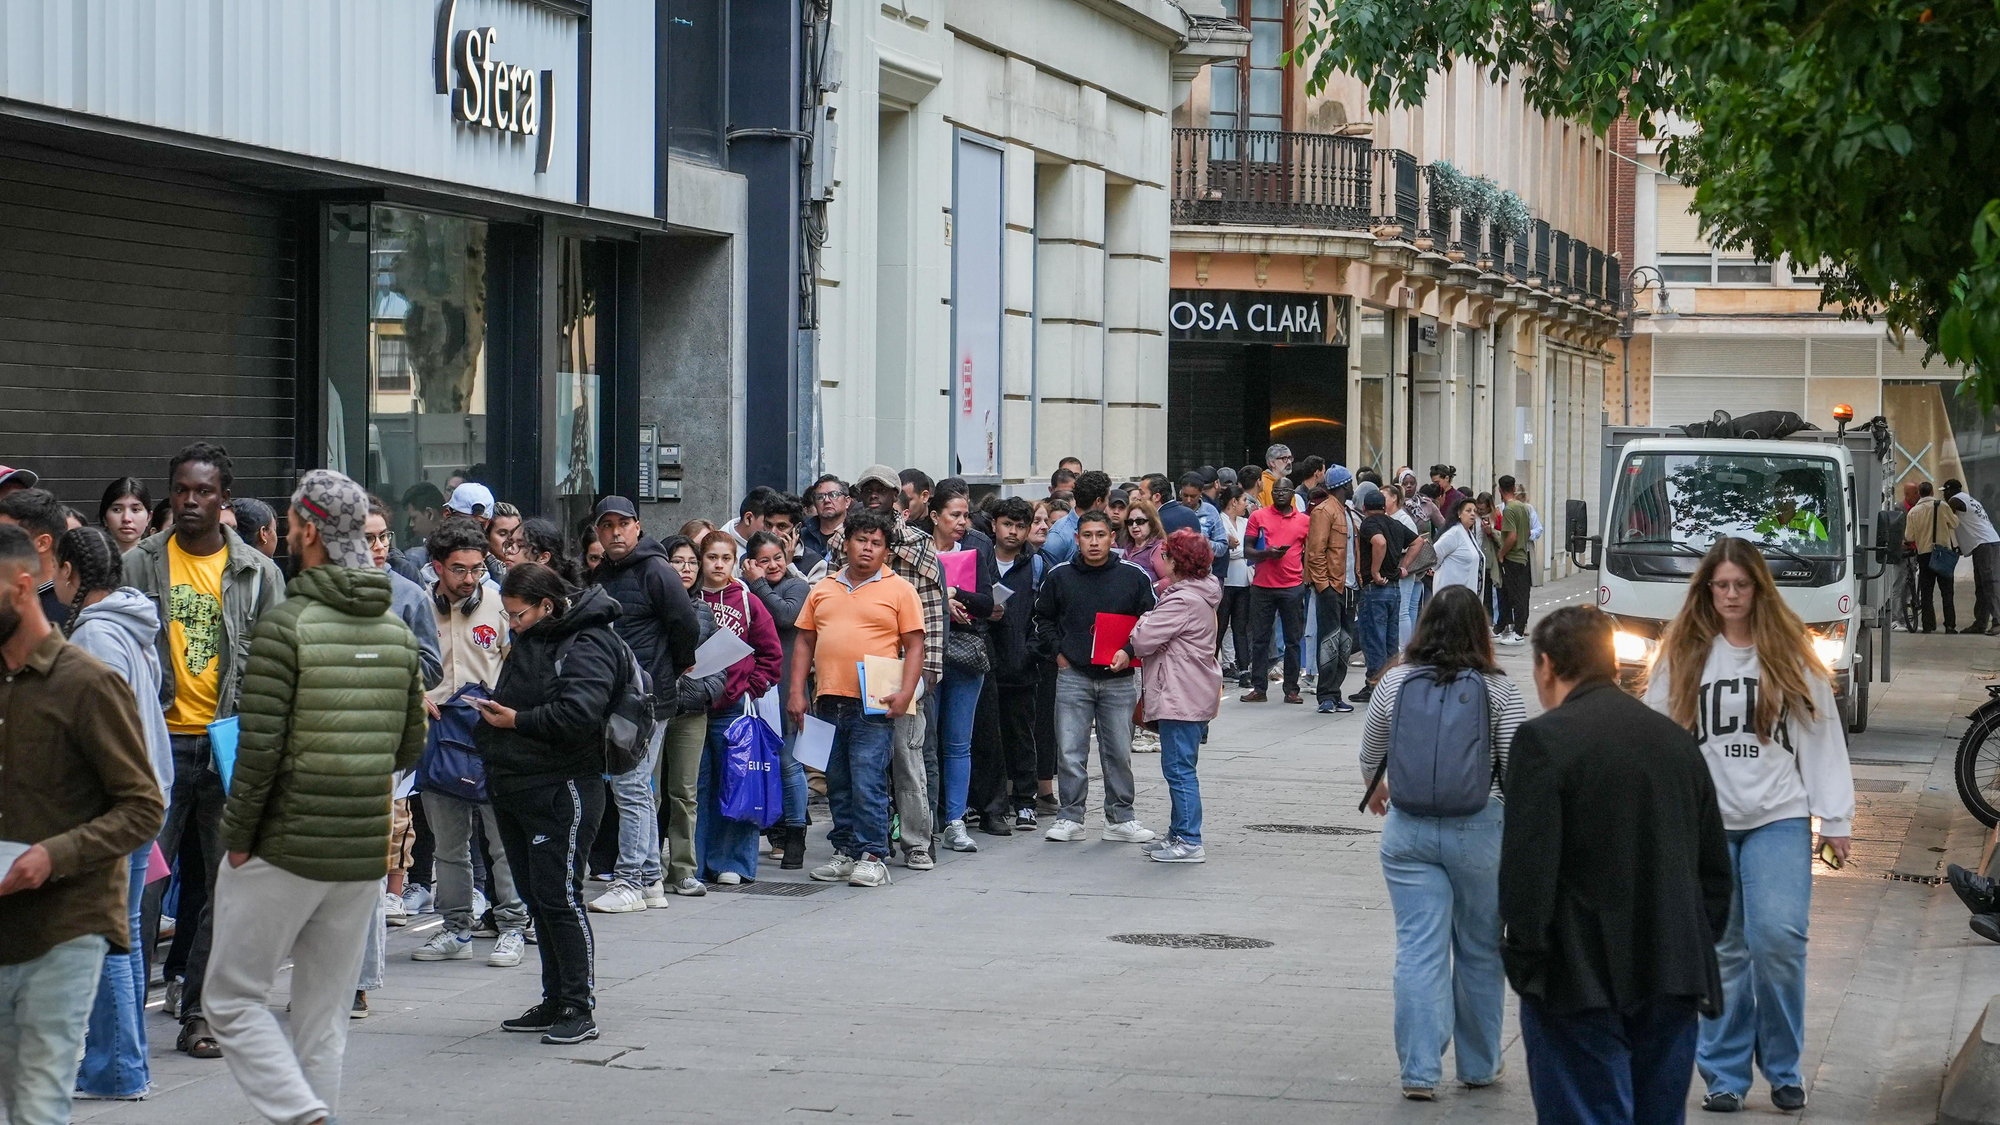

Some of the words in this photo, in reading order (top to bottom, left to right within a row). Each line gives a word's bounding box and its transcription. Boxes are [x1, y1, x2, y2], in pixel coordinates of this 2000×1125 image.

[1169, 301, 1239, 331] OSA
[1247, 301, 1322, 333] CLARÁ
[714, 612, 745, 637] GELES
[1724, 744, 1760, 759] 1919
